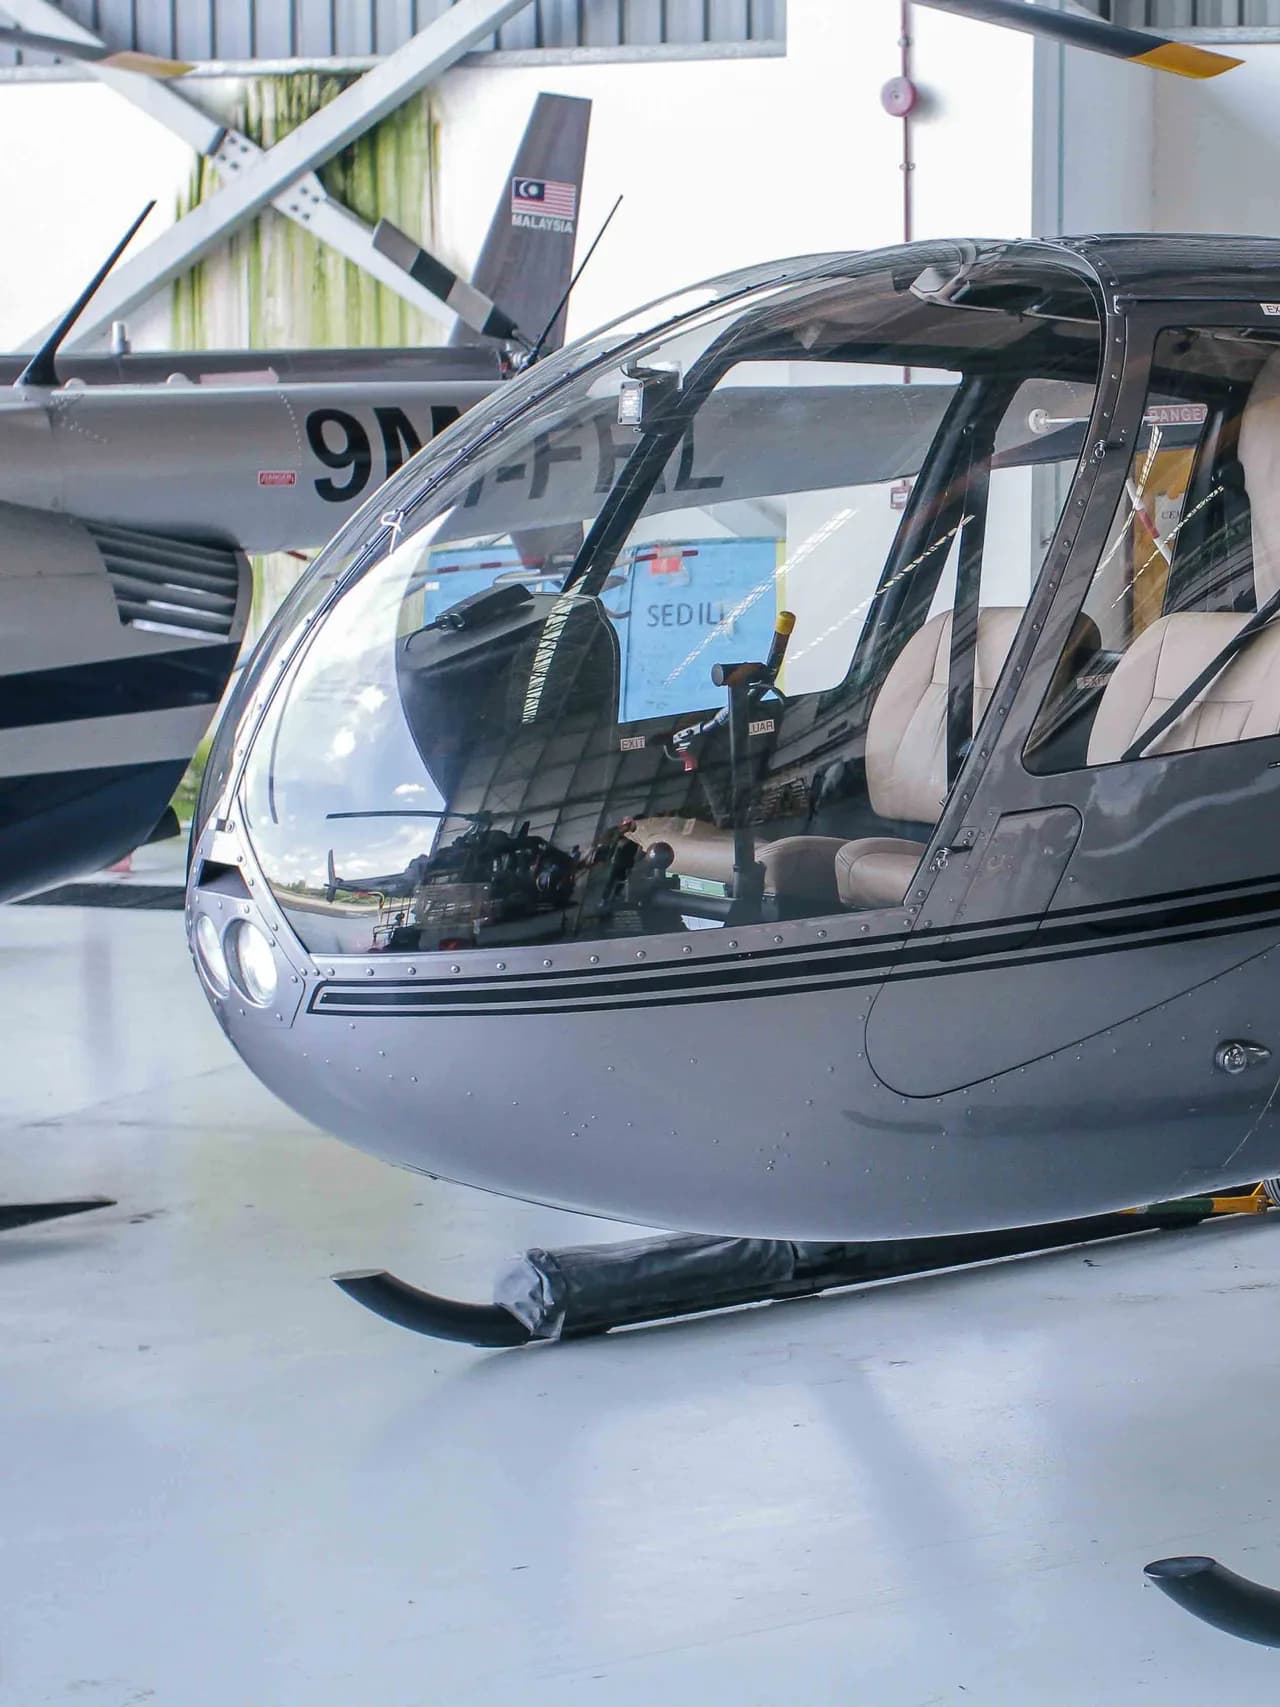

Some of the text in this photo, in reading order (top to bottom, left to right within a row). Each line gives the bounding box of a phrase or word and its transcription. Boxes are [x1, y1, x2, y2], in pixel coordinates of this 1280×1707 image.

[512, 213, 574, 233] MALAYSIA
[1147, 407, 1208, 422] DANGE
[622, 738, 645, 750] EXIT
